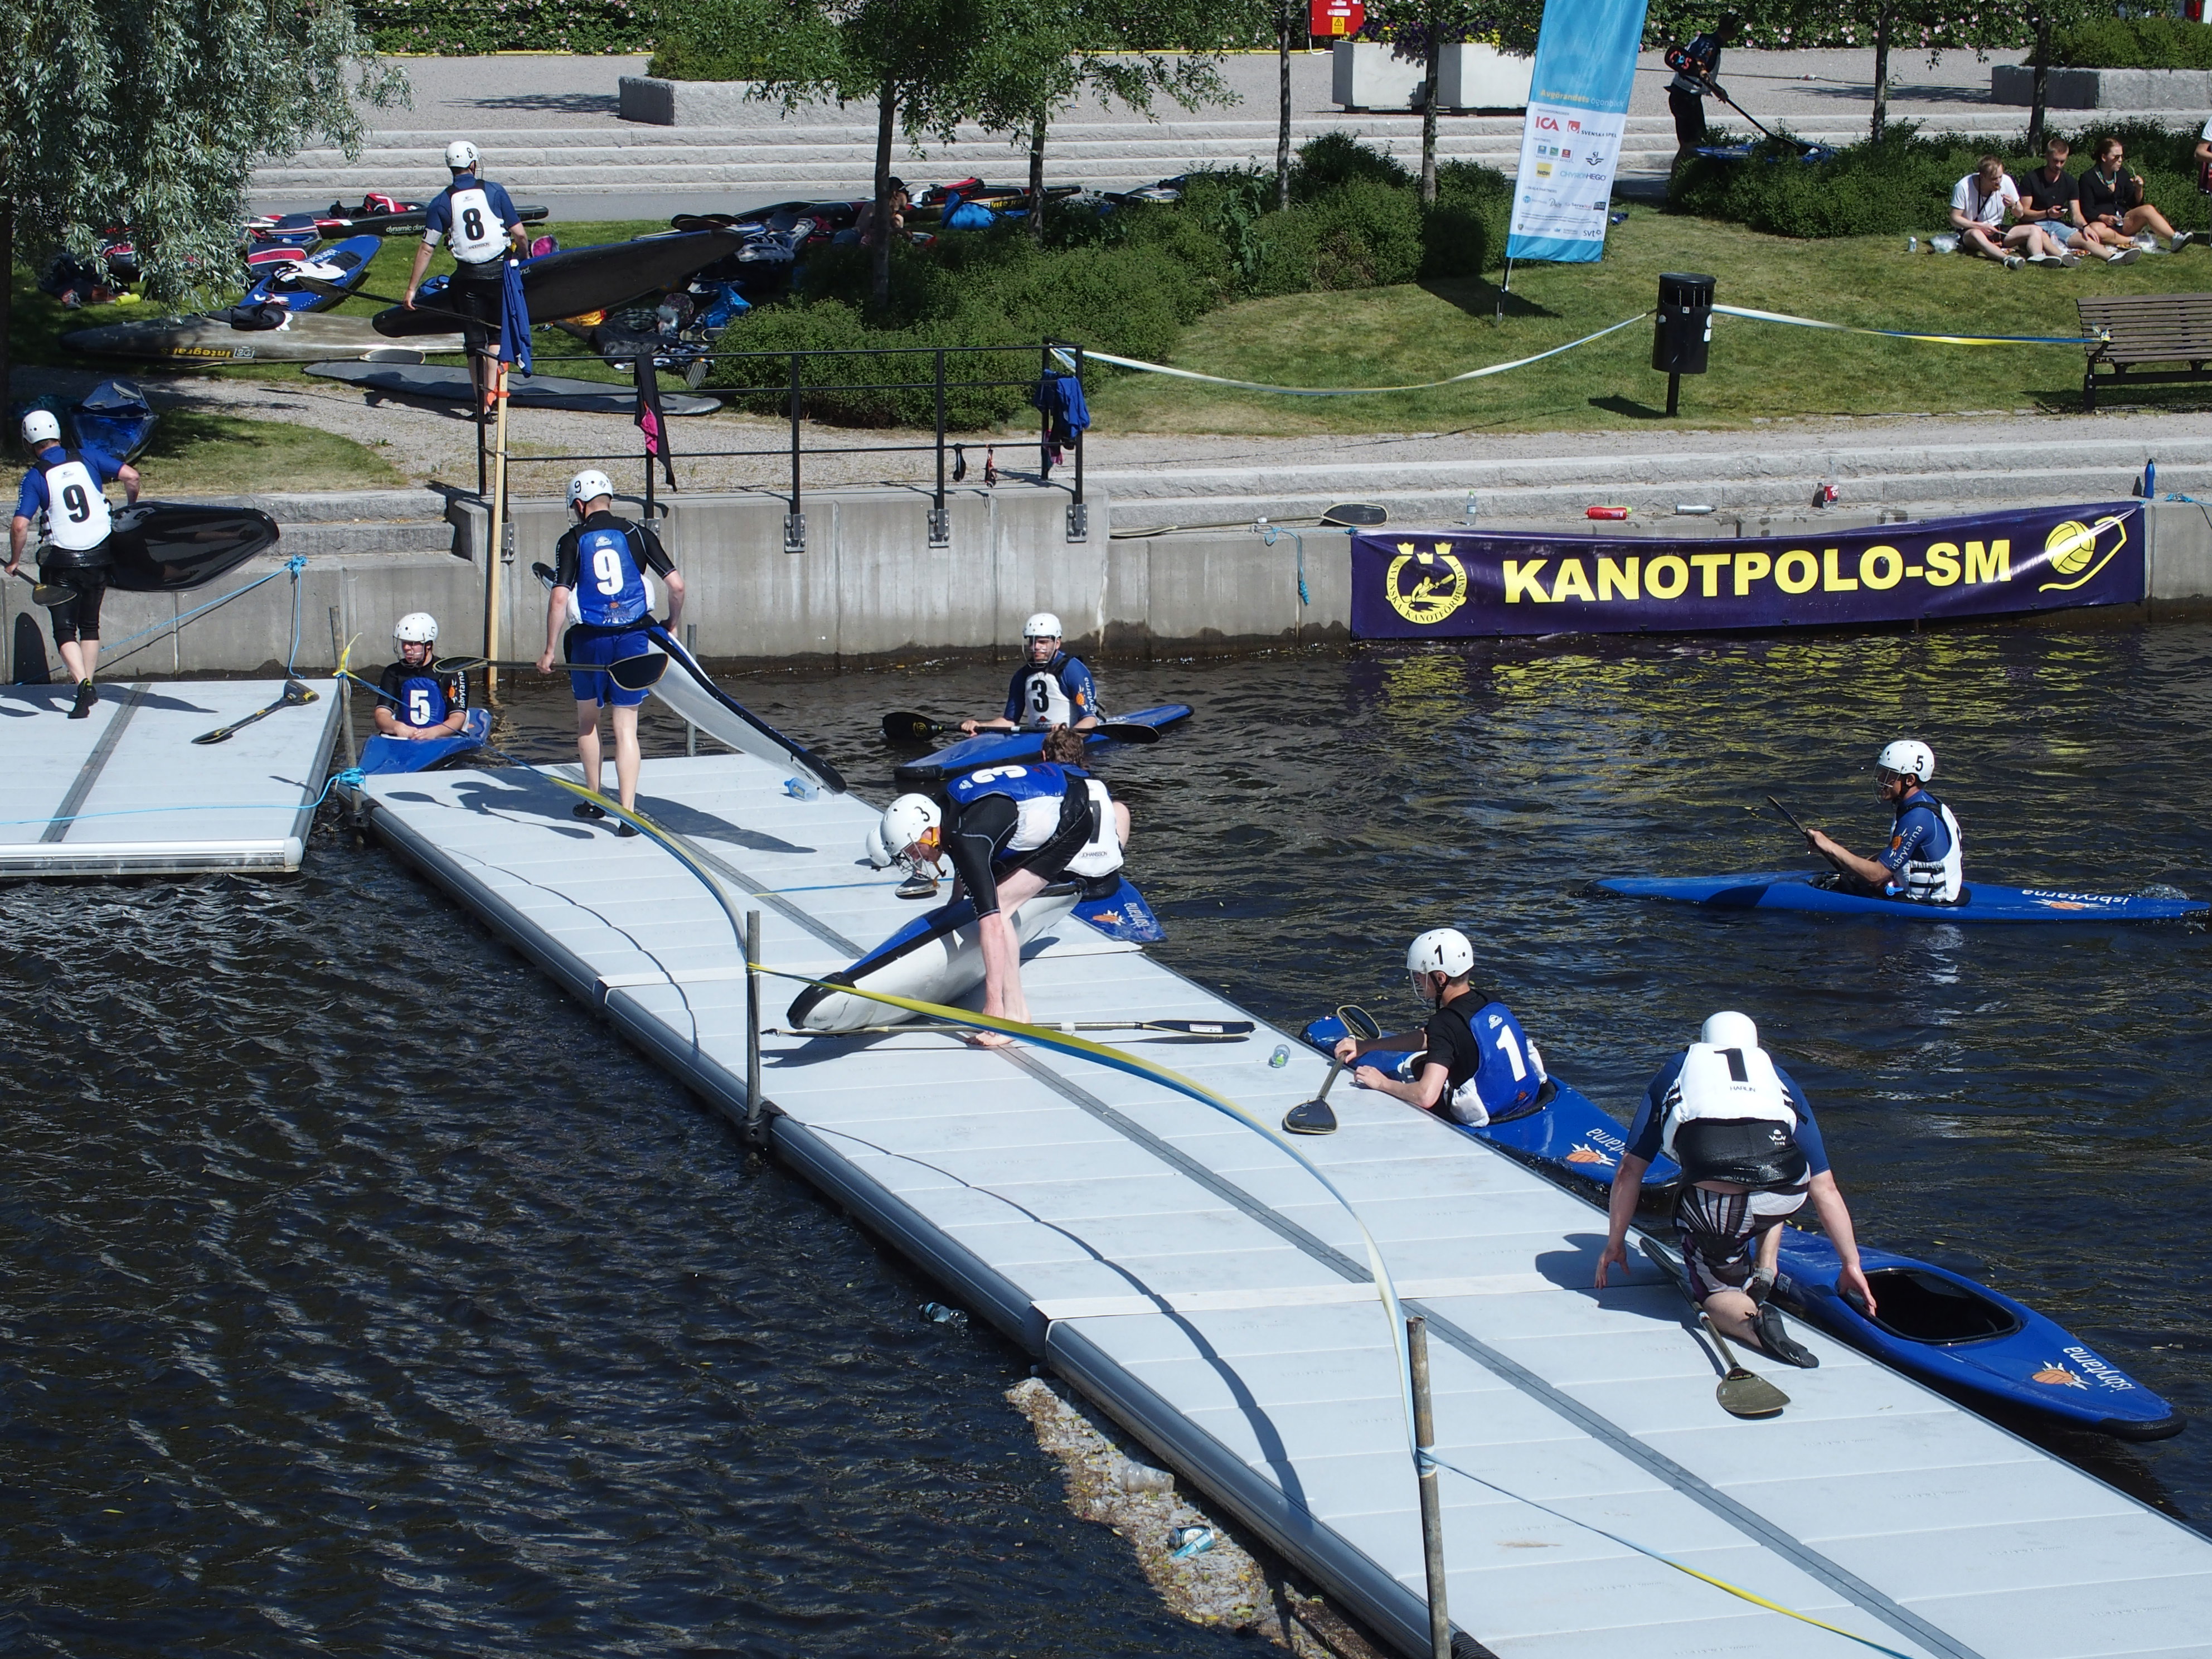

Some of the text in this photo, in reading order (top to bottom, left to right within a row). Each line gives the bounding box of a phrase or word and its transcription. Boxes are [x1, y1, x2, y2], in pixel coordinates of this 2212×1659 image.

[1540, 89, 1625, 108] Avgörandets ögonblick
[1535, 116, 1559, 132] ICA
[467, 147, 473, 159] 8
[386, 224, 413, 234] dynamic
[462, 208, 485, 241] 8
[173, 347, 231, 358] Integral
[574, 480, 582, 493] 9
[62, 484, 90, 523] 9
[593, 548, 624, 595] 9
[1502, 539, 2011, 604] KANOTPOLO-SM
[1389, 562, 1402, 611] SVENSKA
[429, 626, 435, 638] 5
[458, 671, 467, 709] isbrytarna
[1031, 680, 1049, 712] 3
[410, 690, 430, 725] 5
[971, 765, 1027, 783] 3
[1915, 755, 1924, 772] 5
[914, 806, 930, 822] 3
[1891, 824, 1924, 870] isbrytarna
[2021, 889, 2130, 905] isbrytarna
[1434, 944, 1444, 965] 1
[1495, 1024, 1527, 1082] 1
[1713, 1047, 1749, 1082] 1
[2063, 1346, 2136, 1393] isbrytarna
